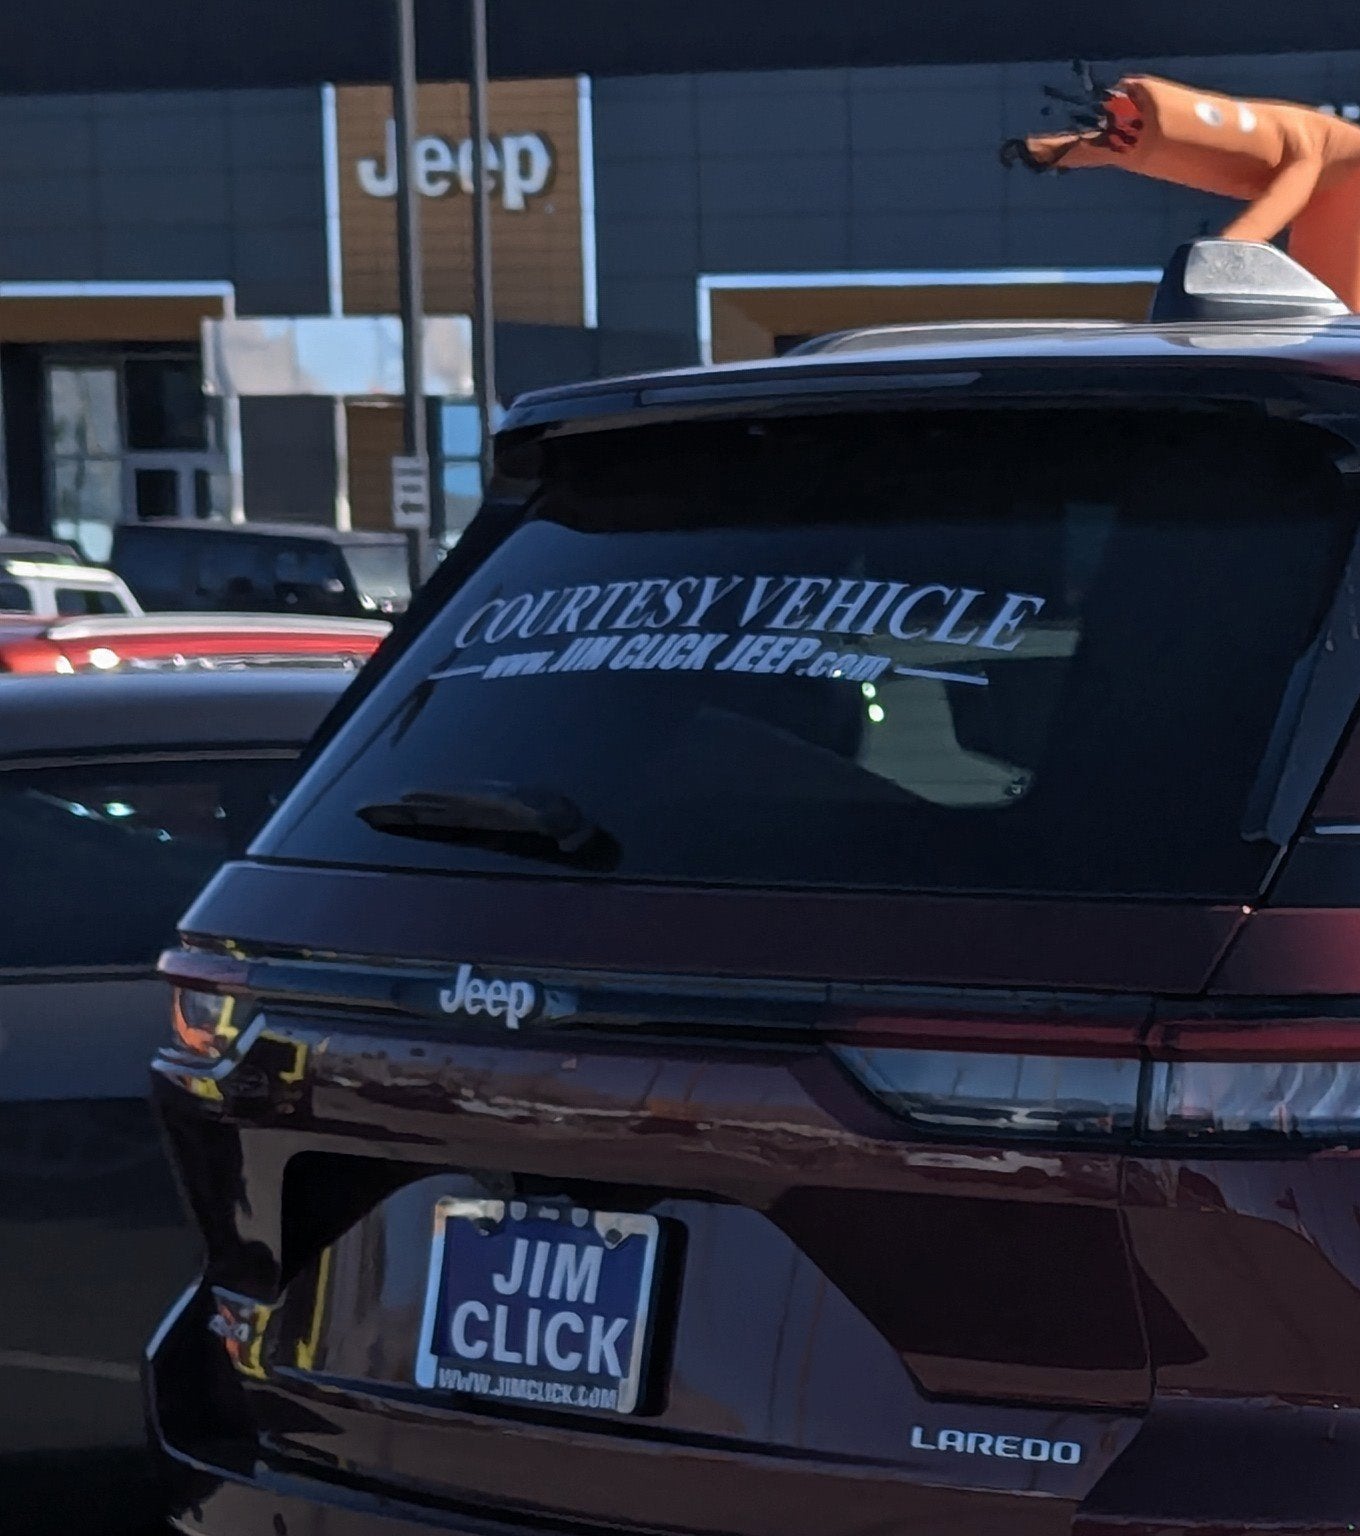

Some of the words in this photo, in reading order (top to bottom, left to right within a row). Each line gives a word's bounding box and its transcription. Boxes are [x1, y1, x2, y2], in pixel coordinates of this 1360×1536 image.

[357, 119, 550, 210] Jeep
[455, 576, 744, 649] COURTESY
[739, 575, 1046, 651] VEHICLE
[439, 963, 537, 1030] Jeep
[492, 1238, 604, 1305] JIM
[452, 1300, 629, 1379] CLICK
[438, 1367, 619, 1410] WWW.JIMCLICK.COM
[910, 1426, 1082, 1465] LAREDO
